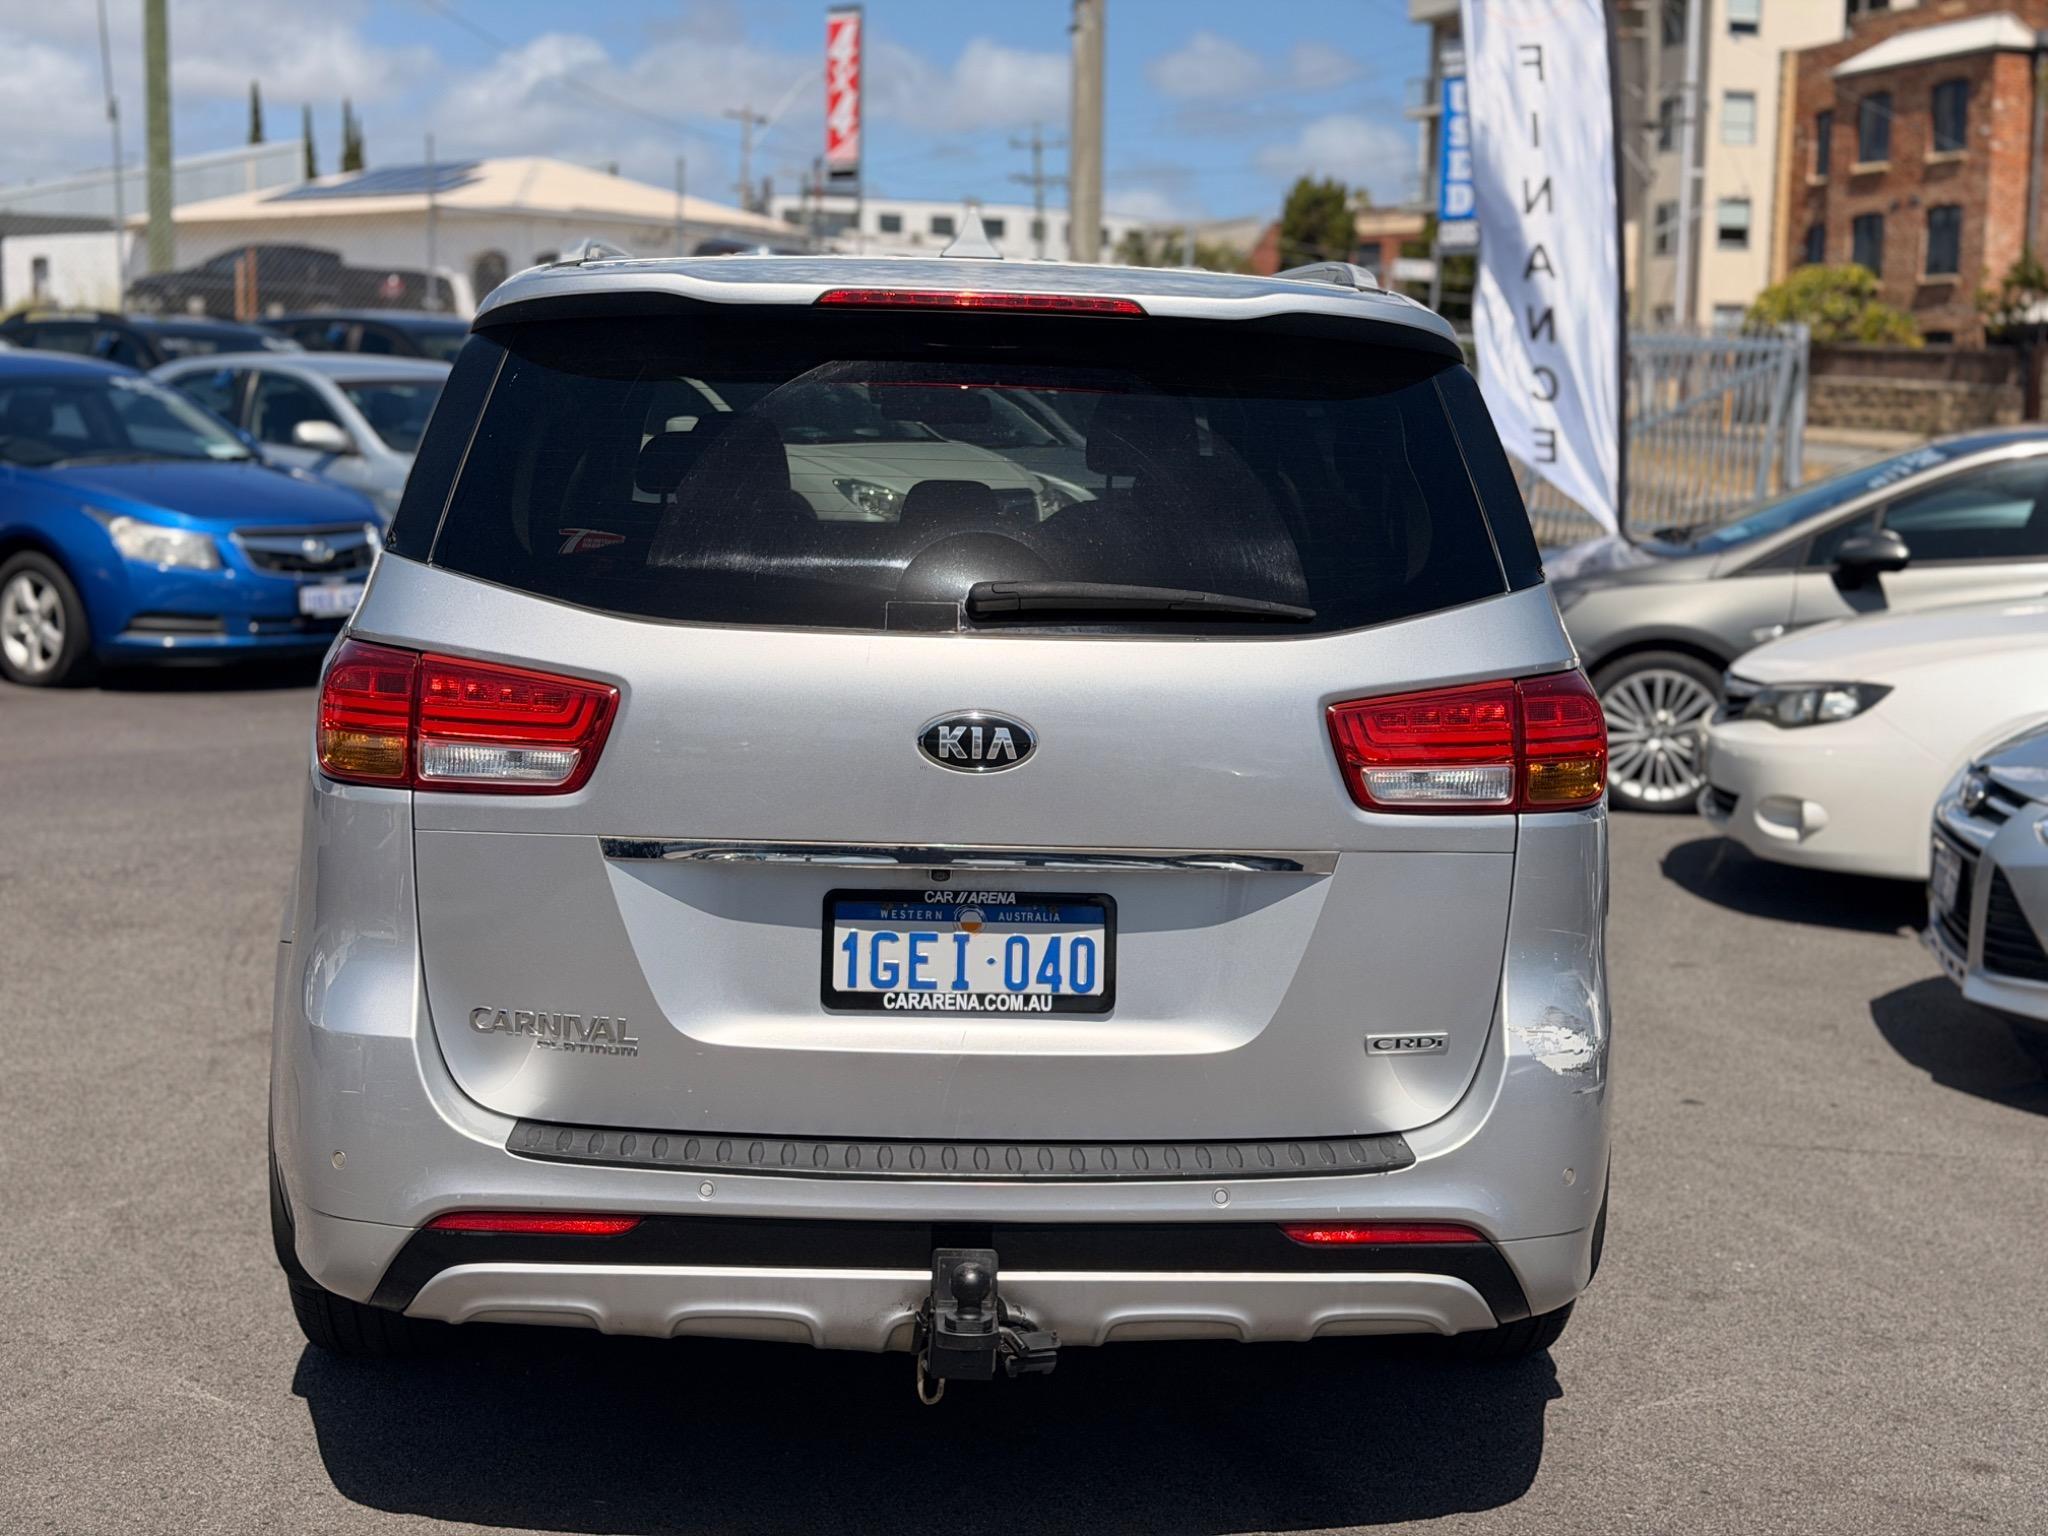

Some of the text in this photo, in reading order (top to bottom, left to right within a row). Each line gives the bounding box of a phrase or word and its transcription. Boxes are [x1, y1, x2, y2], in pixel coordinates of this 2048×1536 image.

[937, 726, 1018, 760] KIA
[924, 890, 954, 904] CAR
[880, 909, 1061, 922] WESTERN AUSTRALIA
[883, 992, 1053, 1012] CARARENA.COM.AU
[469, 1005, 639, 1043] CARNIVAL
